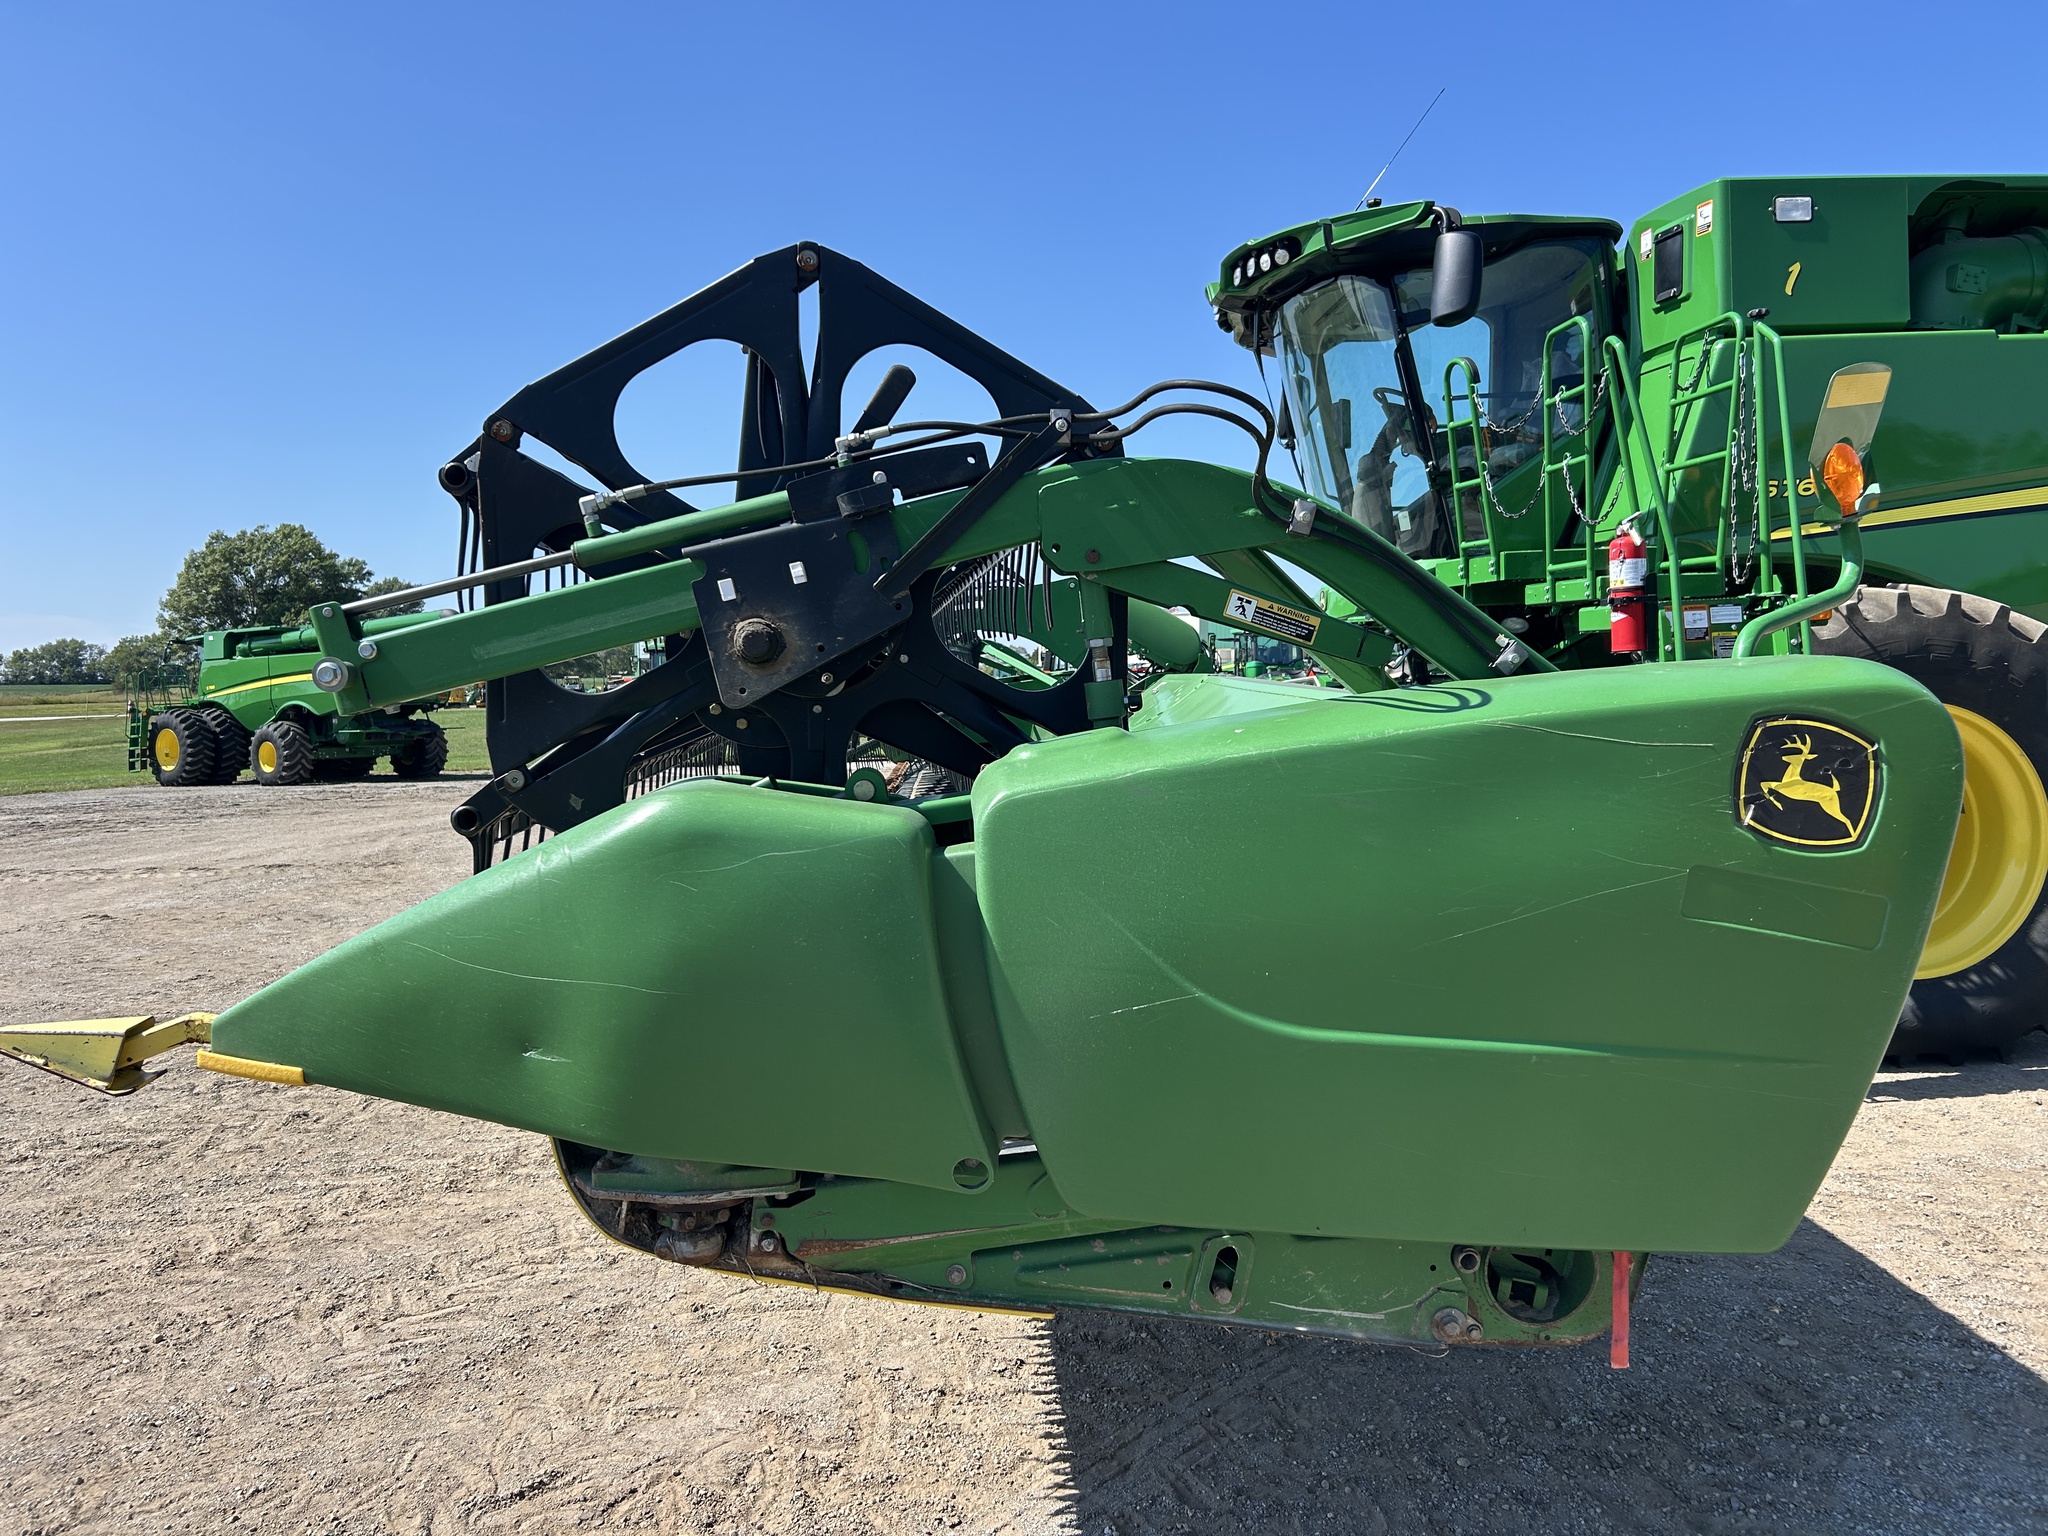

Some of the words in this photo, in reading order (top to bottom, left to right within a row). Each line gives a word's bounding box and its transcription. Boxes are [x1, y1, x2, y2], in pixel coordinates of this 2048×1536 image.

[1785, 261, 1801, 296] 1
[1768, 478, 1816, 498] S76
[1277, 605, 1310, 622] WARNING
